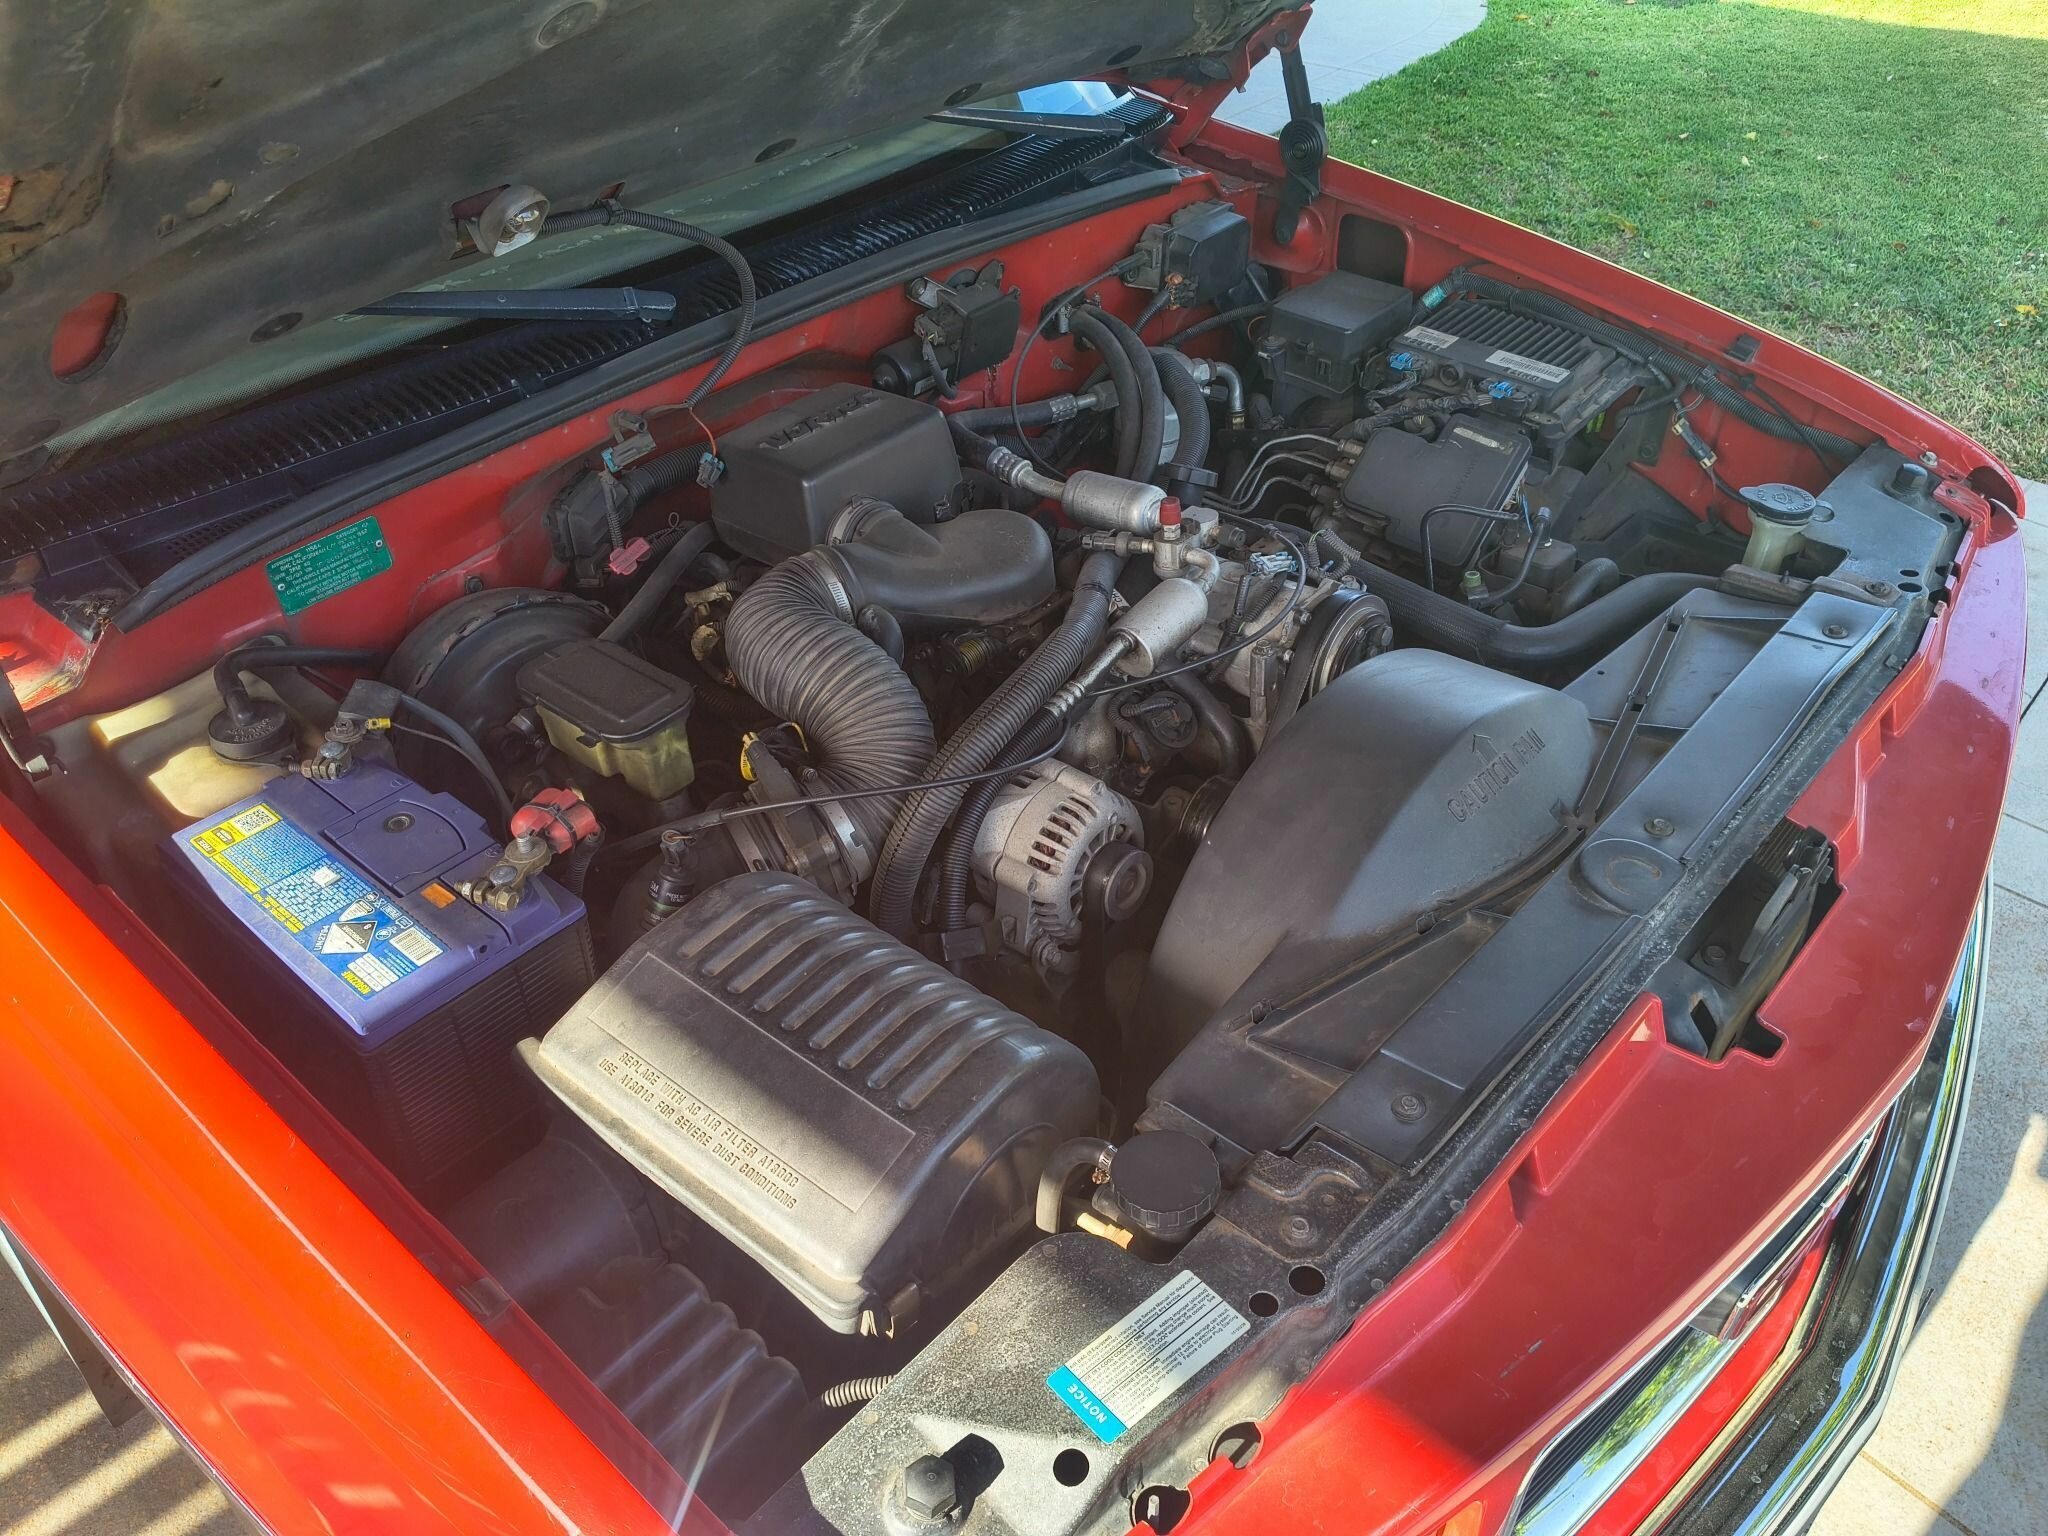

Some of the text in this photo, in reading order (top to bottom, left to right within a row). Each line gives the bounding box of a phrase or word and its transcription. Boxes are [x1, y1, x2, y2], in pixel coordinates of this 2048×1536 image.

[1448, 727, 1546, 823] CAUTION FAN
[599, 1058, 619, 1077] USE
[655, 1100, 676, 1119] FOR
[674, 1114, 713, 1147] SEVERE
[712, 1143, 740, 1166] DUST
[738, 1163, 797, 1210] CONDITIONS
[618, 1051, 661, 1086] REPLACE
[660, 1082, 688, 1106] WITH
[685, 1102, 702, 1116] AC
[700, 1113, 722, 1132] AIR
[721, 1128, 758, 1159] FILTER
[1113, 1340, 1134, 1357] COOLANT
[1067, 1382, 1108, 1424] NOTICE
